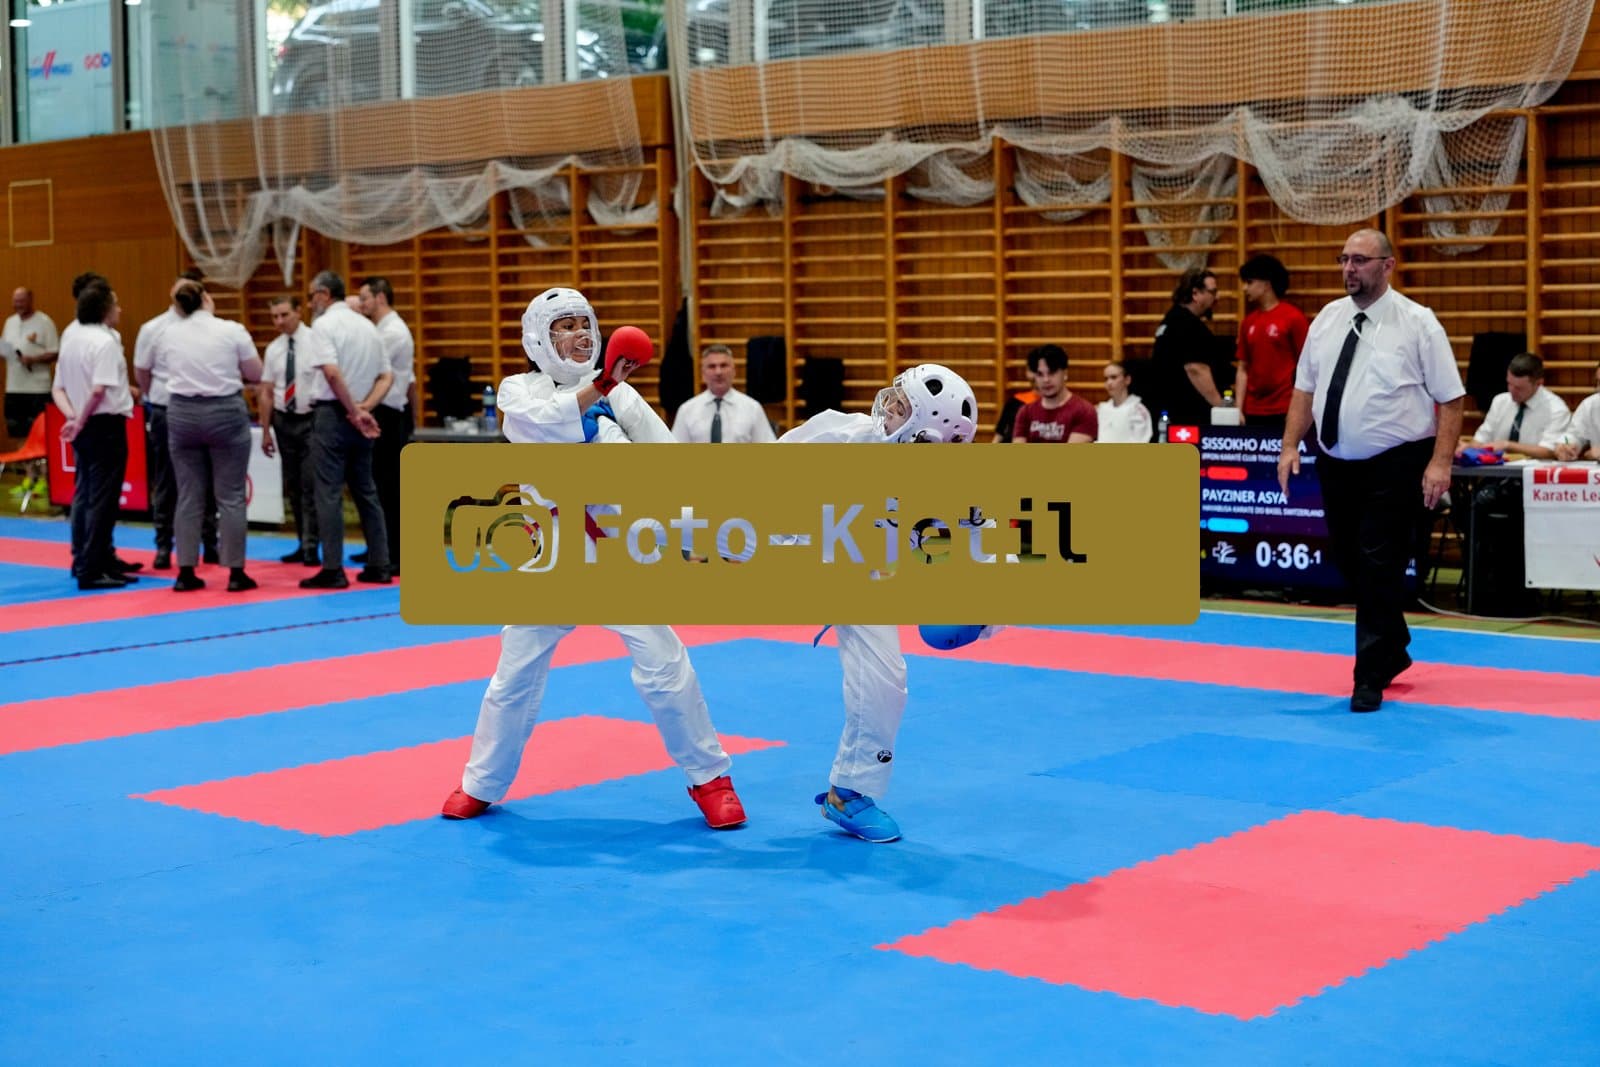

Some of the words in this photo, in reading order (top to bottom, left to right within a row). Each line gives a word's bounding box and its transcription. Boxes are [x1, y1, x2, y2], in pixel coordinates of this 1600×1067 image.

[1201, 436, 1258, 451] SISSOKHO
[1259, 438, 1307, 453] AISSA
[1202, 488, 1256, 503] PAYZINER
[1257, 490, 1288, 505] ASYA
[1533, 489, 1577, 502] Karate
